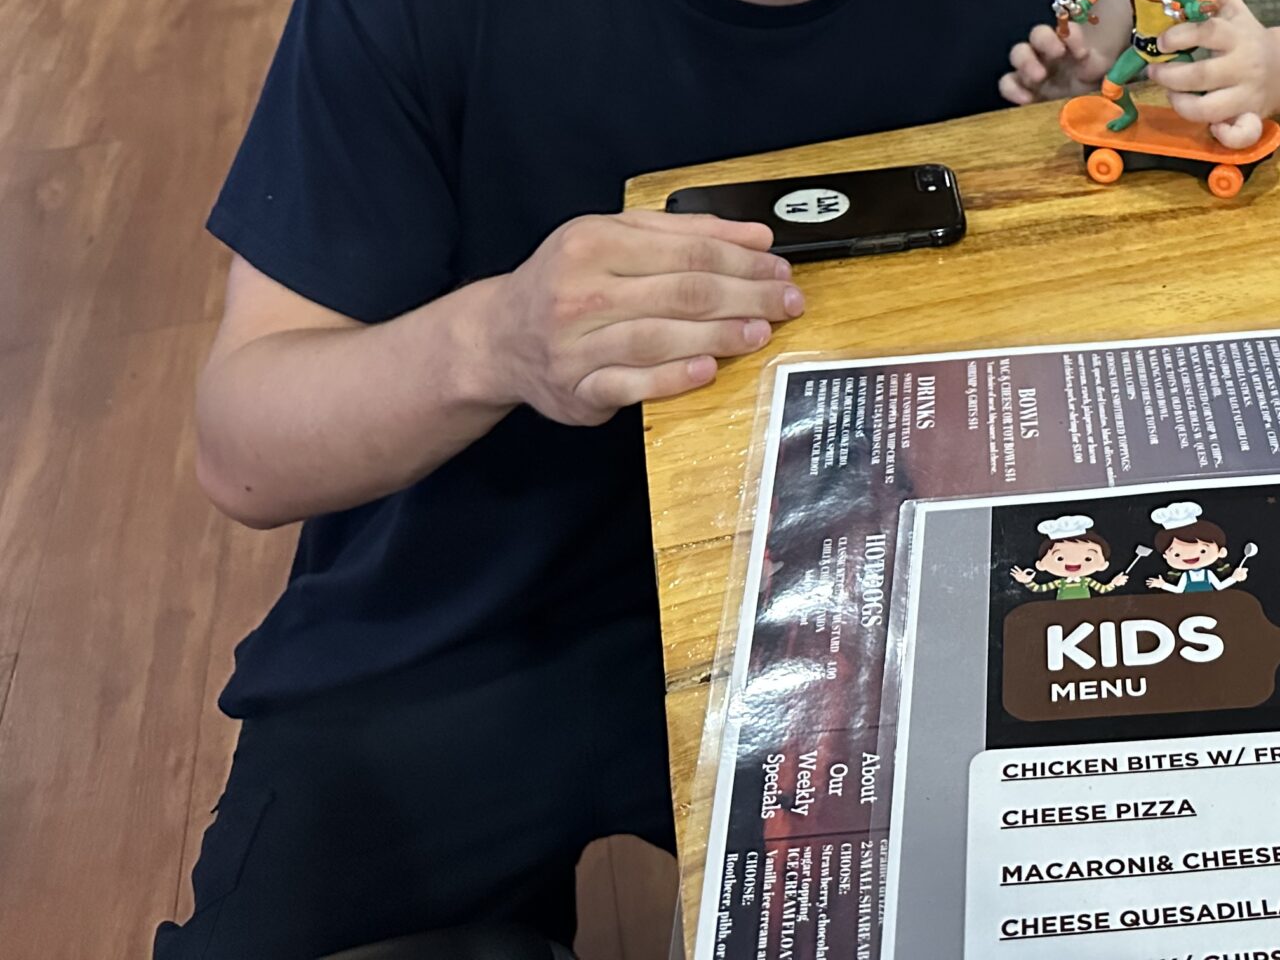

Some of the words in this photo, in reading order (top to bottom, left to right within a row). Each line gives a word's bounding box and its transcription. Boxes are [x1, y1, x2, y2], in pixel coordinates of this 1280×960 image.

[786, 202, 808, 214] 14
[816, 195, 840, 215] LM
[916, 375, 935, 429] DRINKS
[1017, 387, 1039, 438] BOWLS
[863, 534, 886, 573] HOT
[860, 574, 884, 627] DOGS
[1045, 615, 1226, 672] KIDS
[1050, 676, 1148, 703] MENU
[828, 763, 849, 797] Our
[860, 752, 881, 804] About
[1001, 757, 1119, 780] CHICKEN
[1127, 751, 1200, 772] BITES
[1207, 746, 1246, 767] W/
[761, 753, 786, 819] Specials
[791, 751, 818, 816] Weekly
[1001, 804, 1108, 827] CHEESE
[1116, 798, 1196, 820] PIZZA
[785, 847, 801, 870] ICE
[798, 846, 813, 877] sugar
[860, 840, 873, 849] 2
[740, 850, 758, 906] CHOOSE:
[762, 849, 778, 890] Vanilla
[837, 842, 852, 895] CHOOSE:
[858, 850, 873, 894] SMALL
[1001, 854, 1174, 884] MACARONI&
[760, 891, 775, 909] ice
[781, 870, 799, 919] CREAM
[795, 877, 813, 922] topping
[756, 910, 771, 949] cream
[1000, 911, 1110, 938] CHEESE
[714, 943, 726, 958] or
